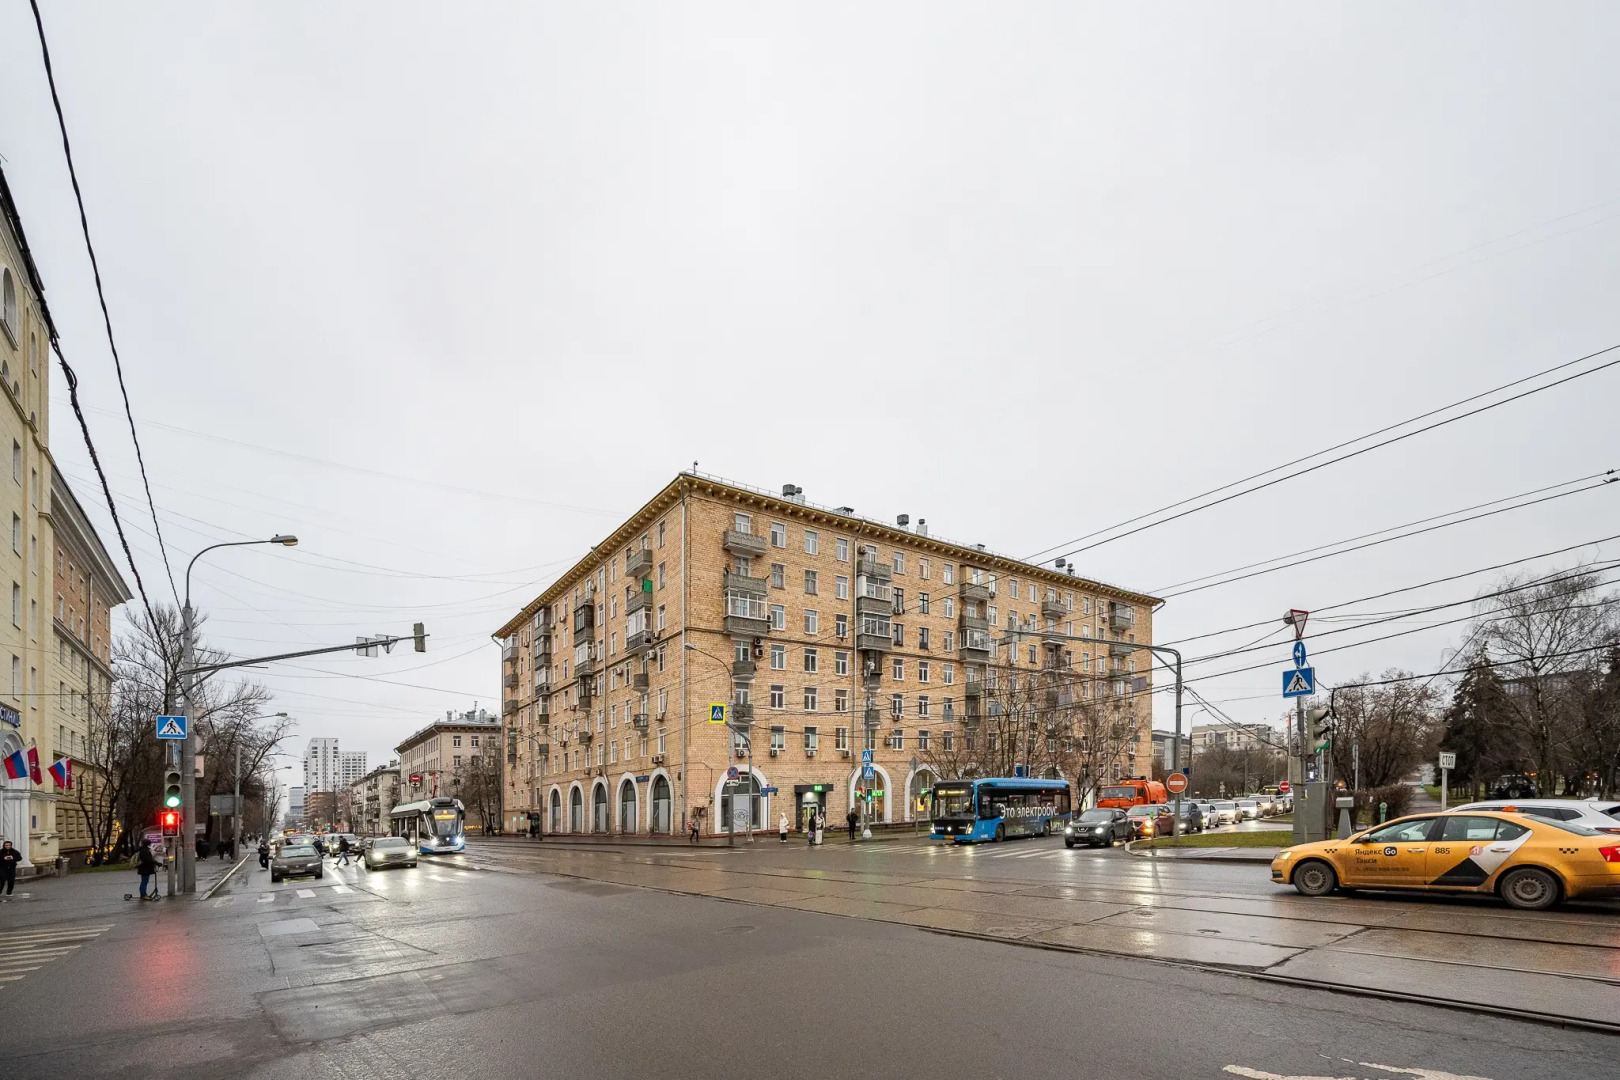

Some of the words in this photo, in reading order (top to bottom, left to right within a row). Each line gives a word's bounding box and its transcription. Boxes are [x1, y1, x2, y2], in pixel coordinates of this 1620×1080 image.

[1442, 755, 1454, 766] СТОП
[999, 803, 1015, 819] Это
[1016, 803, 1059, 820] электробус.
